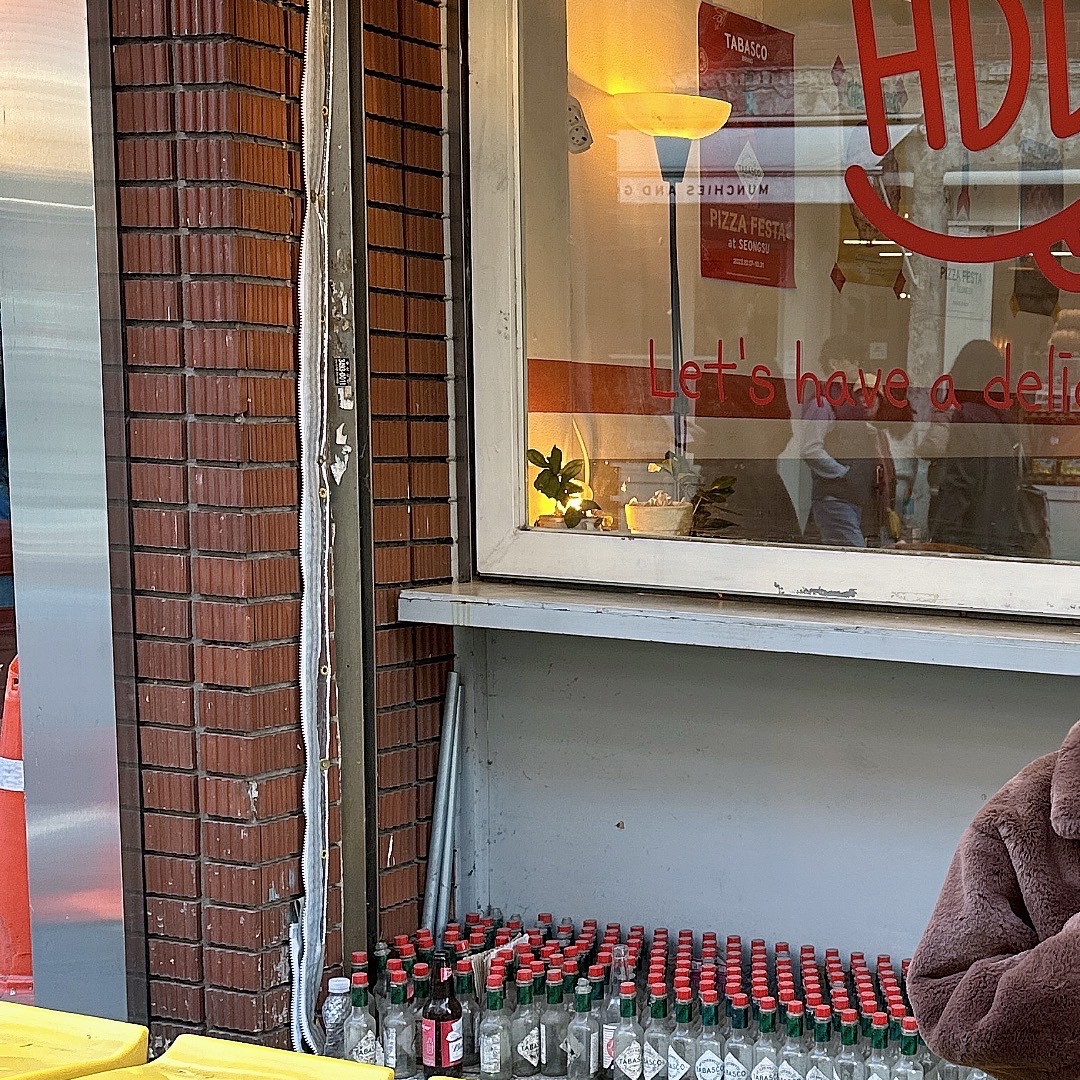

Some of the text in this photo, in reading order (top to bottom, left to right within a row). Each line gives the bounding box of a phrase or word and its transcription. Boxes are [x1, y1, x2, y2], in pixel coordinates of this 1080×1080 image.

[724, 32, 768, 61] TABASCO
[709, 208, 787, 242] PIZZA FESTA
[728, 237, 770, 254] at SEONGSU
[649, 337, 776, 406] Let's
[795, 340, 910, 409] have
[930, 374, 962, 411] a
